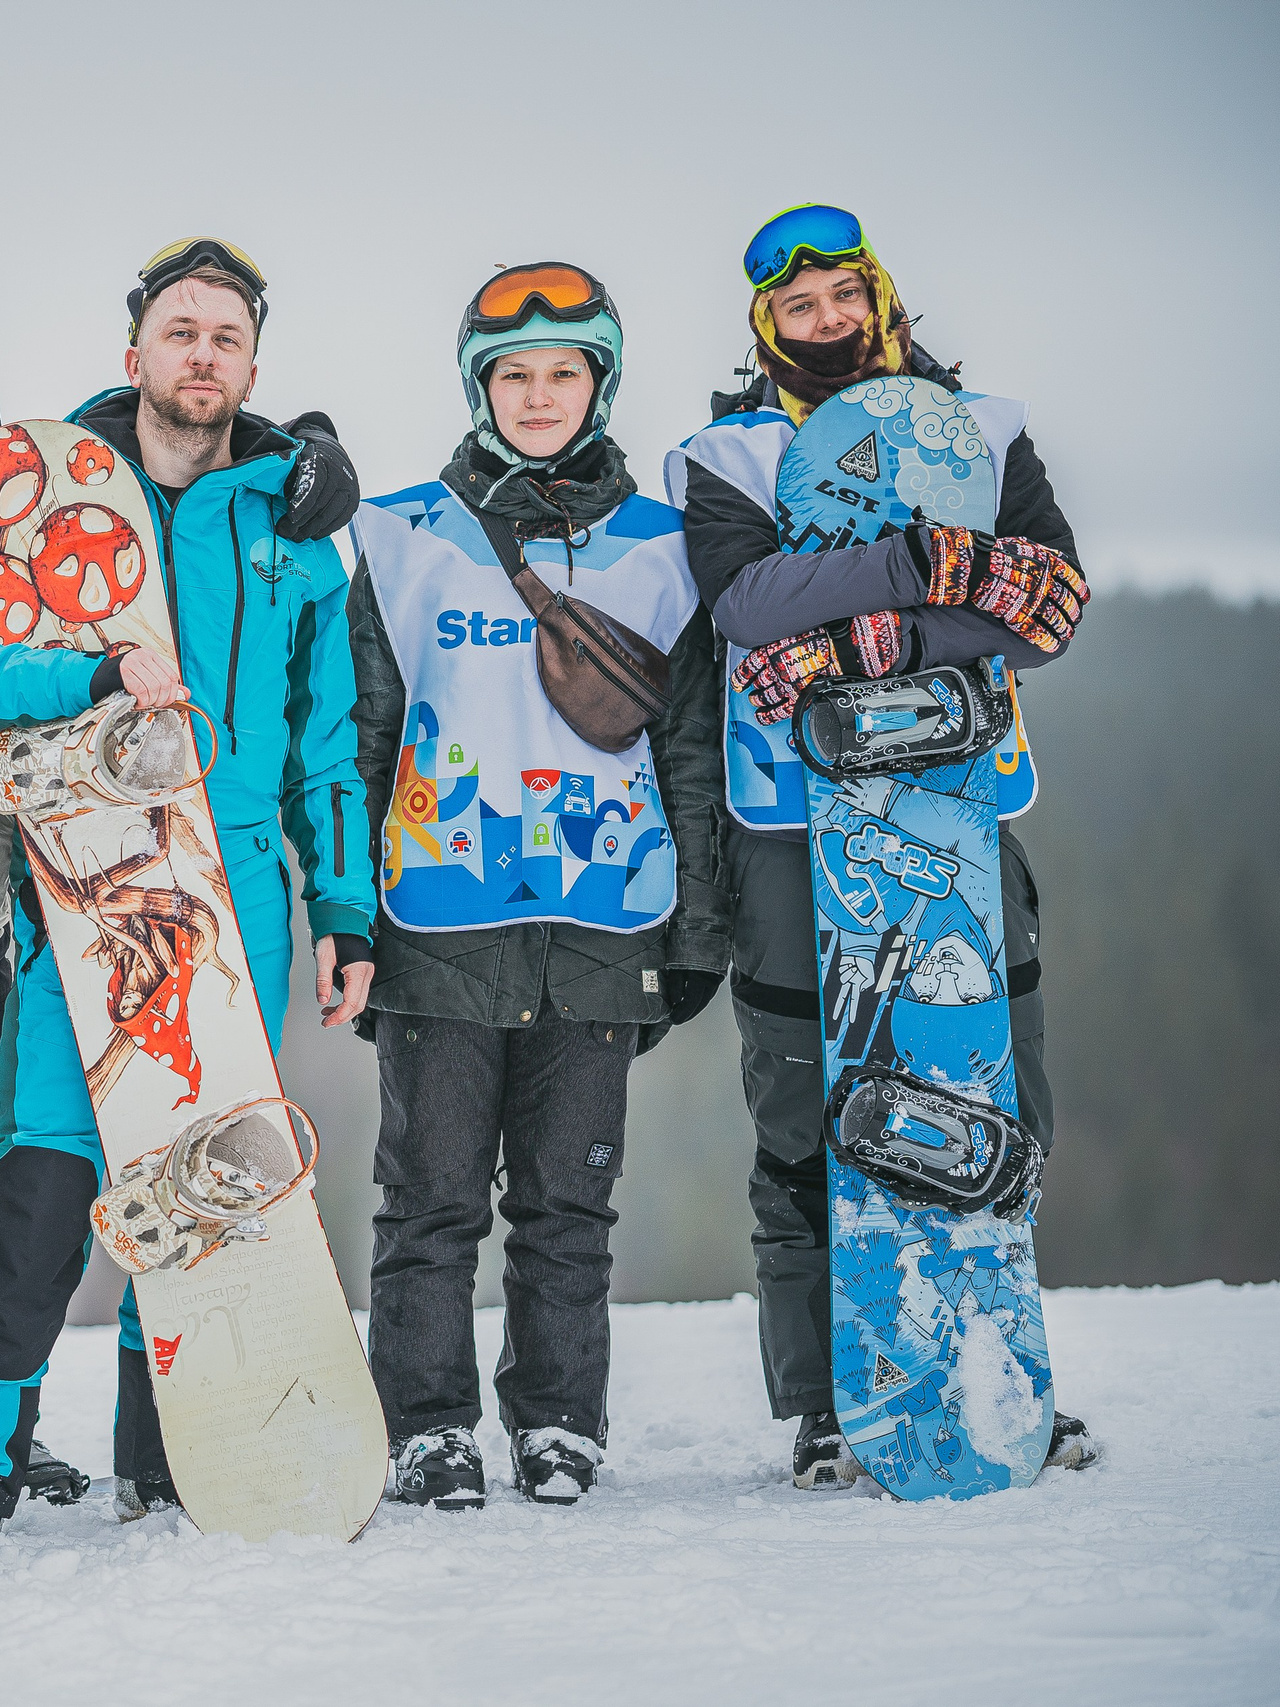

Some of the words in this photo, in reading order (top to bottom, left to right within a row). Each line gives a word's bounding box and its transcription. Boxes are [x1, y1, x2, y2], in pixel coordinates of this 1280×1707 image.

[814, 479, 880, 514] 157
[928, 678, 963, 718] Scoop
[844, 823, 959, 900] Scoop
[969, 1122, 989, 1167] Scoop
[115, 1230, 140, 1255] 390
